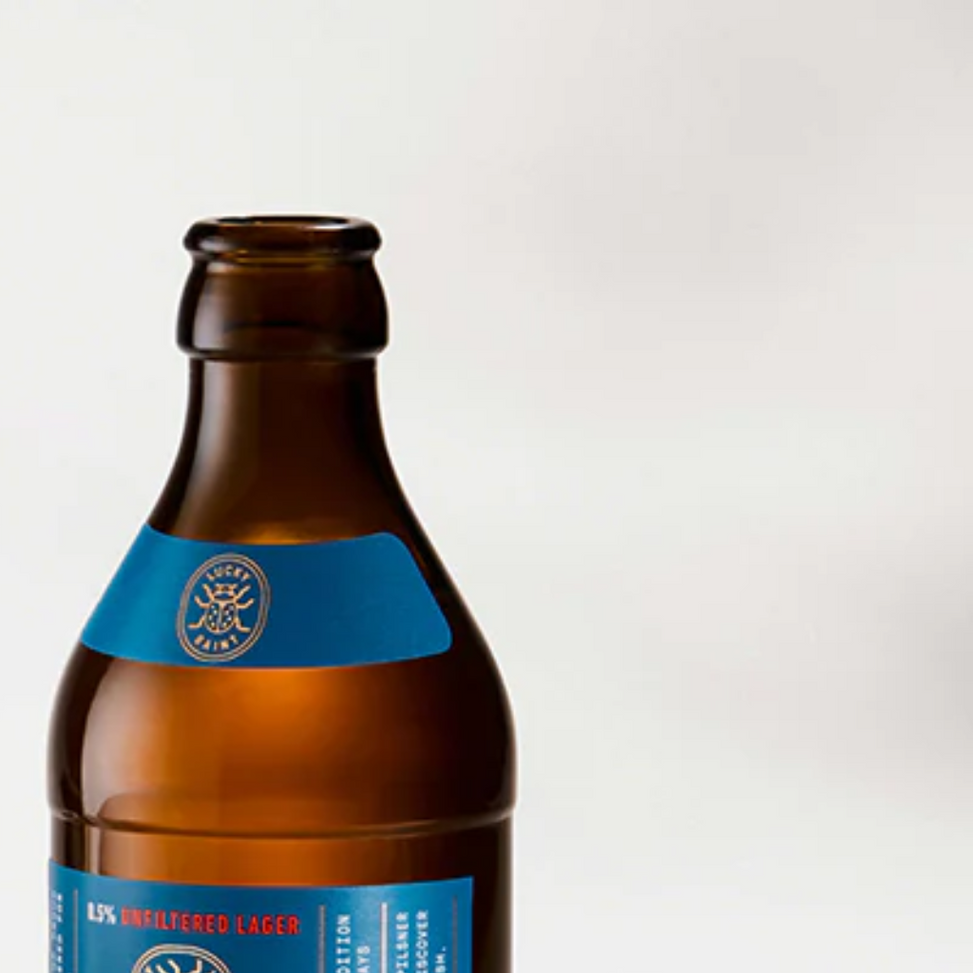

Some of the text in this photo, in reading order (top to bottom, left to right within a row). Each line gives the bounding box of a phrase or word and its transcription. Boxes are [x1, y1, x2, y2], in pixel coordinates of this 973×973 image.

[205, 564, 250, 581] LUCKY
[195, 634, 238, 650] SAINT
[121, 906, 229, 935] UNFILTERED
[236, 914, 301, 935] LAGER
